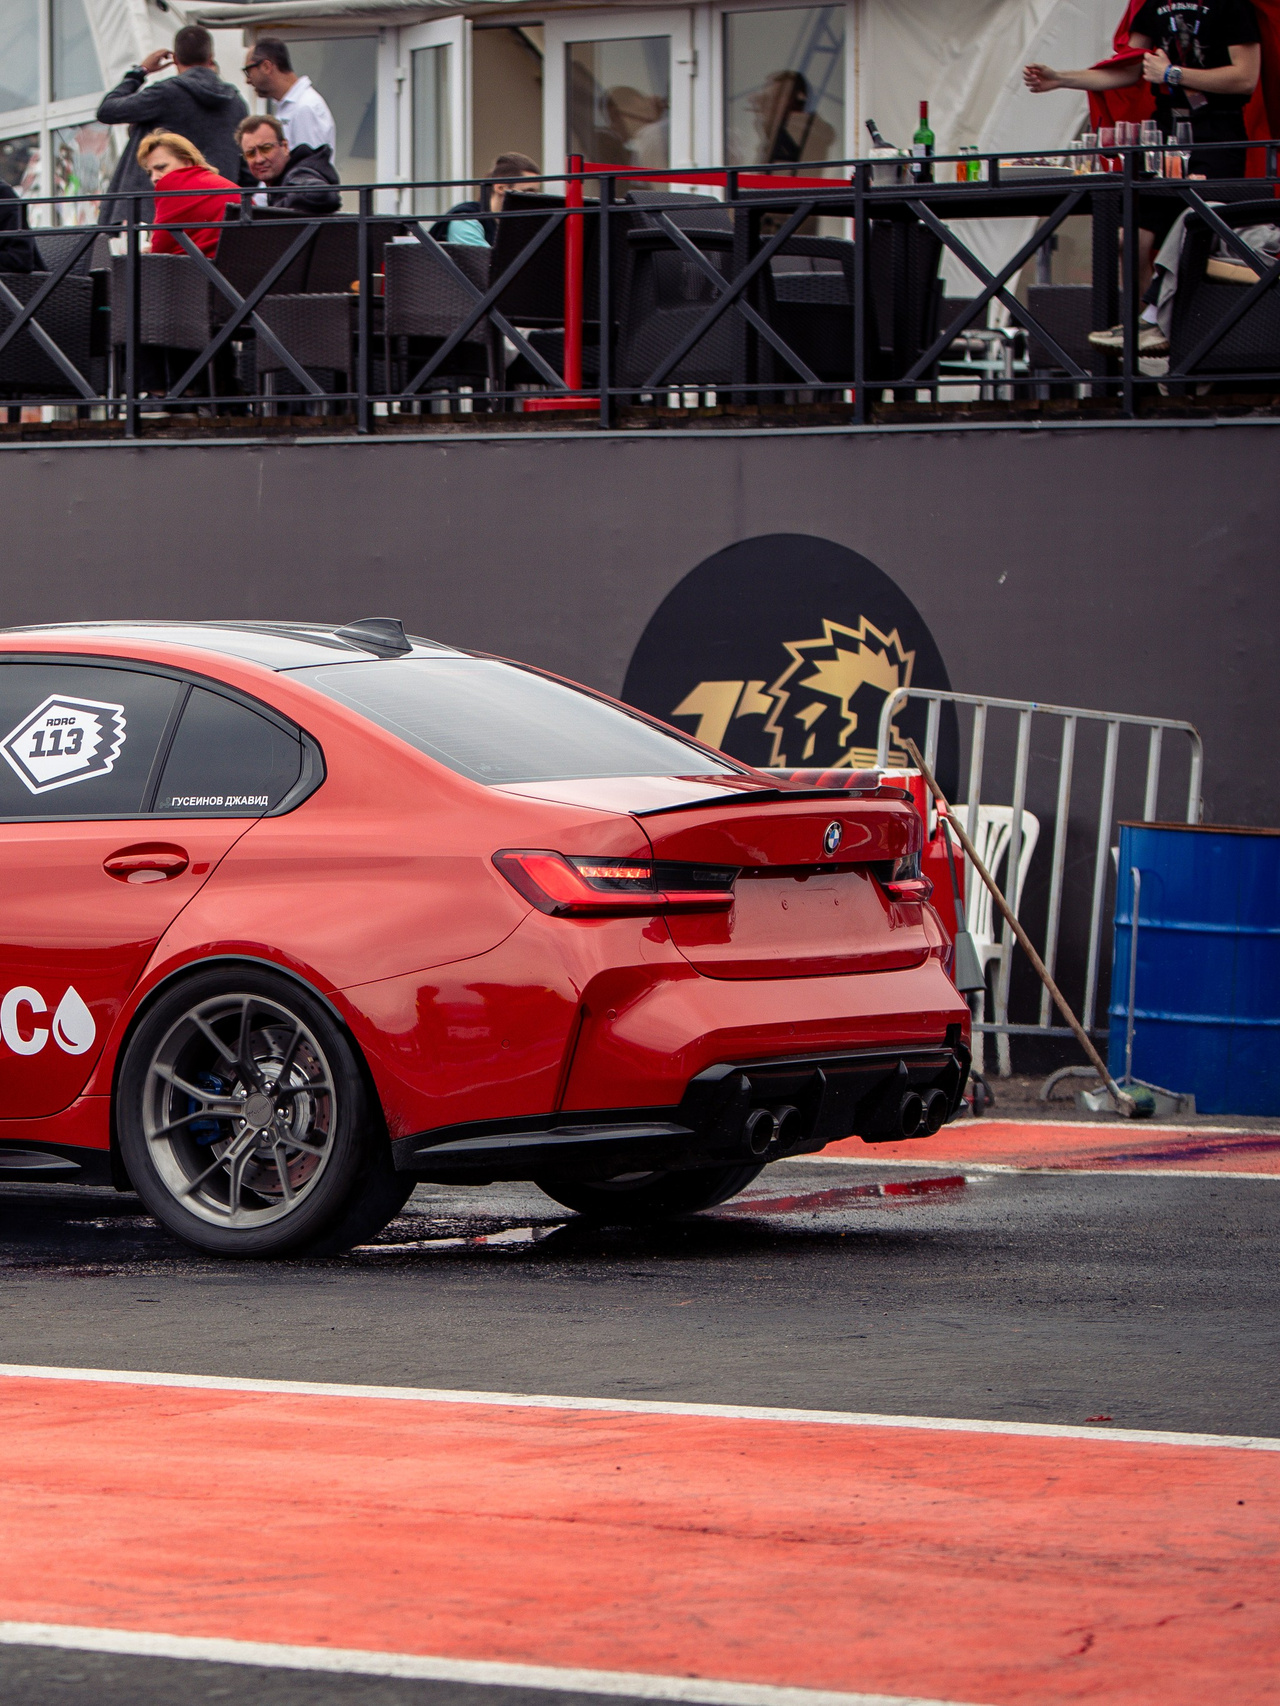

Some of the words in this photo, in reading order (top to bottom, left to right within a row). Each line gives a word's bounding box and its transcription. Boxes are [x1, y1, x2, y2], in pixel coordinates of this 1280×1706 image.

[46, 717, 76, 726] RDRC
[28, 727, 84, 758] 113
[171, 796, 223, 807] ГУСЕИНОВ
[224, 796, 269, 807] ДЖАВИД
